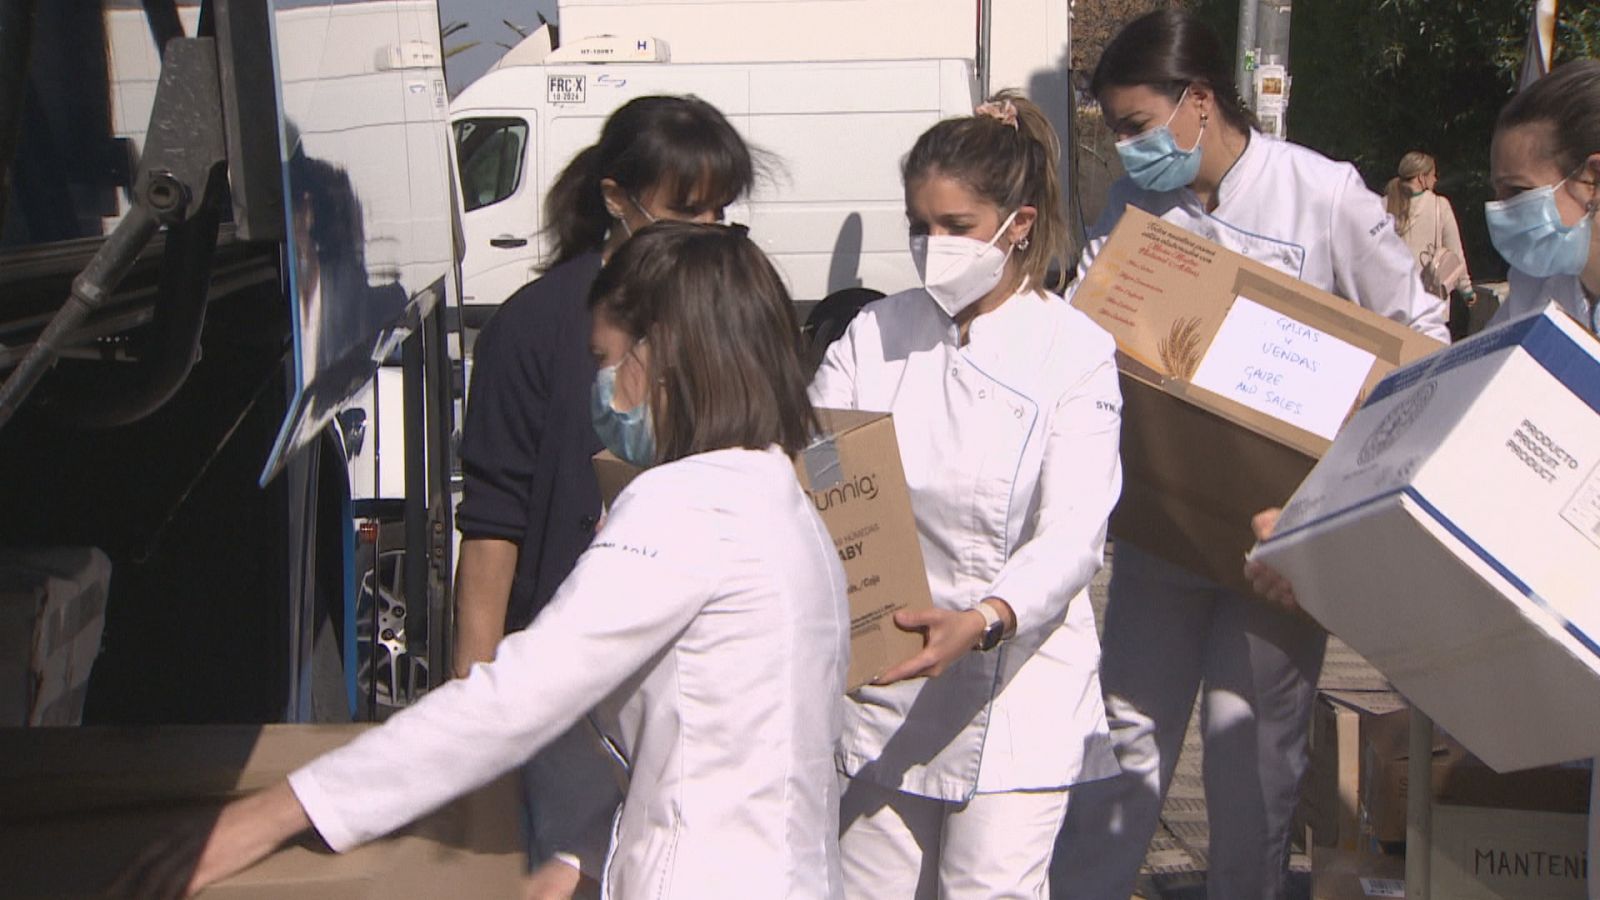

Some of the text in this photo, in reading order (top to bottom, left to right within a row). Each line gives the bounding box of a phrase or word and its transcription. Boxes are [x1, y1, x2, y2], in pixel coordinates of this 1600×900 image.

[637, 40, 647, 50] H
[1262, 342, 1321, 373] VENDAS
[1521, 418, 1579, 470] PRODUCTO
[1504, 439, 1558, 484] PRODUCT
[838, 541, 863, 561] ABY
[1474, 847, 1587, 880] MANTENI
